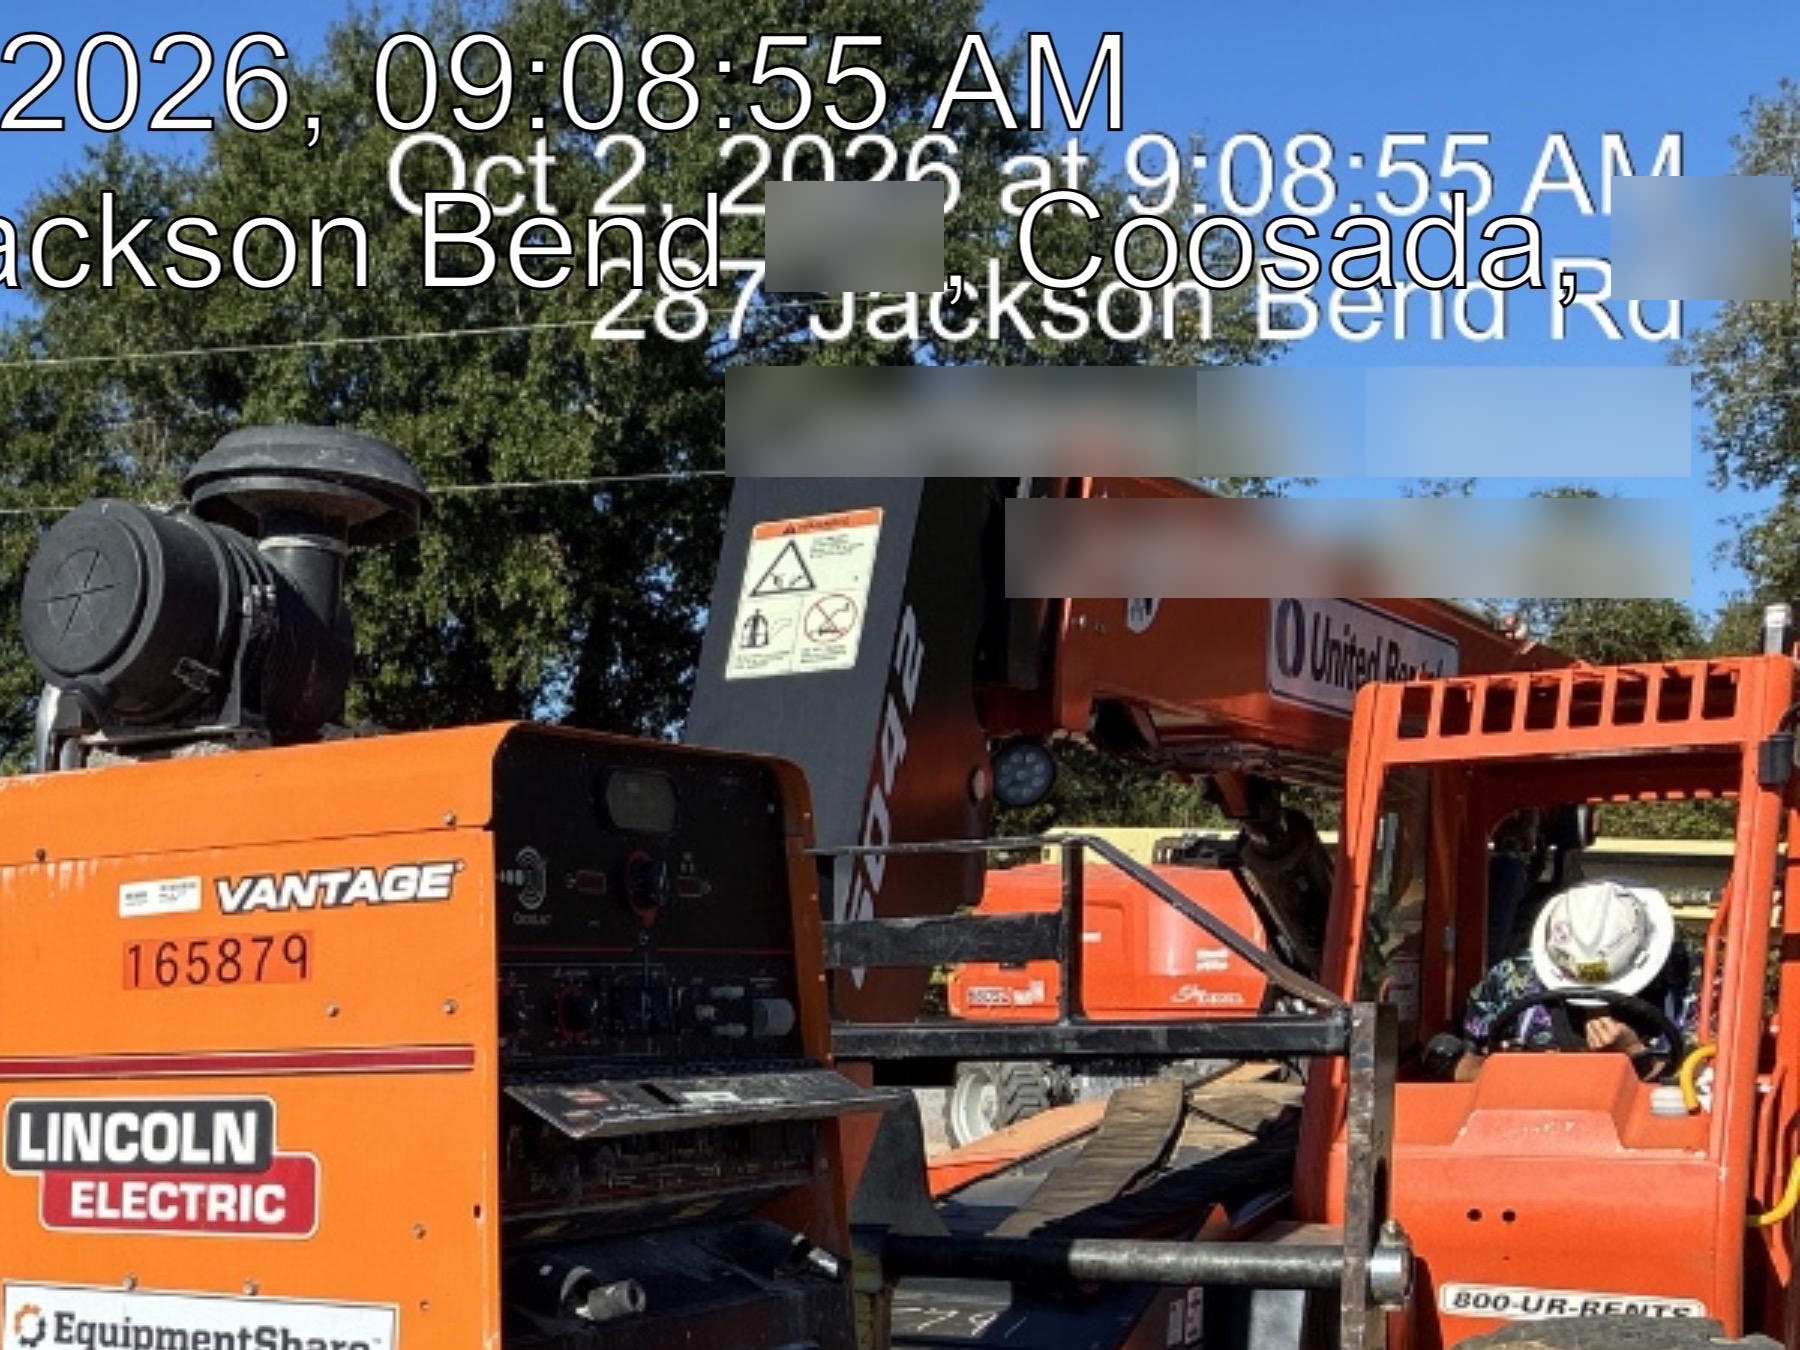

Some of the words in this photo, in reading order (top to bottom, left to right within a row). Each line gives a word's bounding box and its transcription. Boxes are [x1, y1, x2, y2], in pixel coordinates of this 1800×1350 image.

[214, 862, 459, 914] VANTAGE
[127, 933, 308, 988] 165879
[18, 1110, 258, 1164] LINCOLN
[70, 1180, 287, 1224] ELECTRIC
[1453, 1291, 1693, 1319] 800-UR-RENTS
